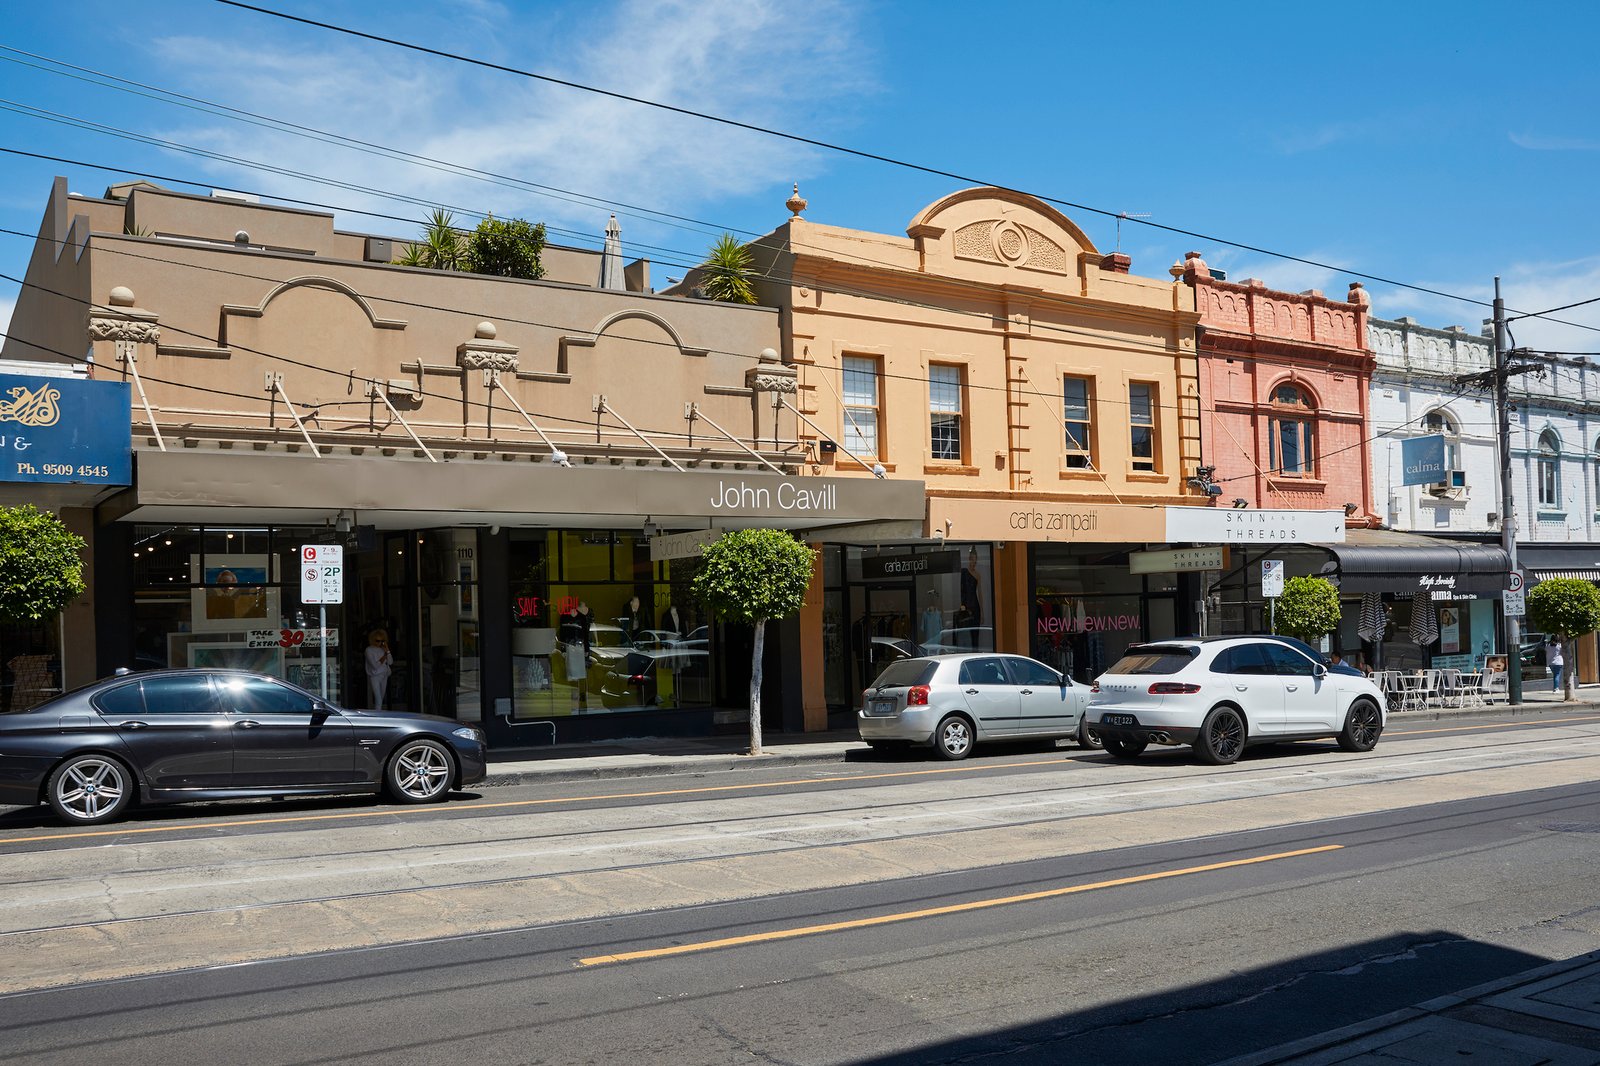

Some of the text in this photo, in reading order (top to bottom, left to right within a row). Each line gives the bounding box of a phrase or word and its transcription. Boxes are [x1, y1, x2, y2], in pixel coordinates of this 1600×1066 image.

[14, 436, 32, 451] &
[17, 462, 109, 477] Ph. 9509 4545
[1406, 460, 1440, 474] calma
[711, 481, 836, 510] John Cavill
[1010, 508, 1098, 537] carla zampatti
[1226, 513, 1265, 522] SKIN
[1226, 529, 1297, 539] THREADS
[457, 548, 473, 559] 1110
[1173, 552, 1199, 560] SKIN
[885, 557, 901, 572] carla
[1174, 560, 1221, 568] THREADS
[324, 567, 340, 576] 2P
[517, 597, 540, 616] SAVE
[279, 629, 304, 648] 30
